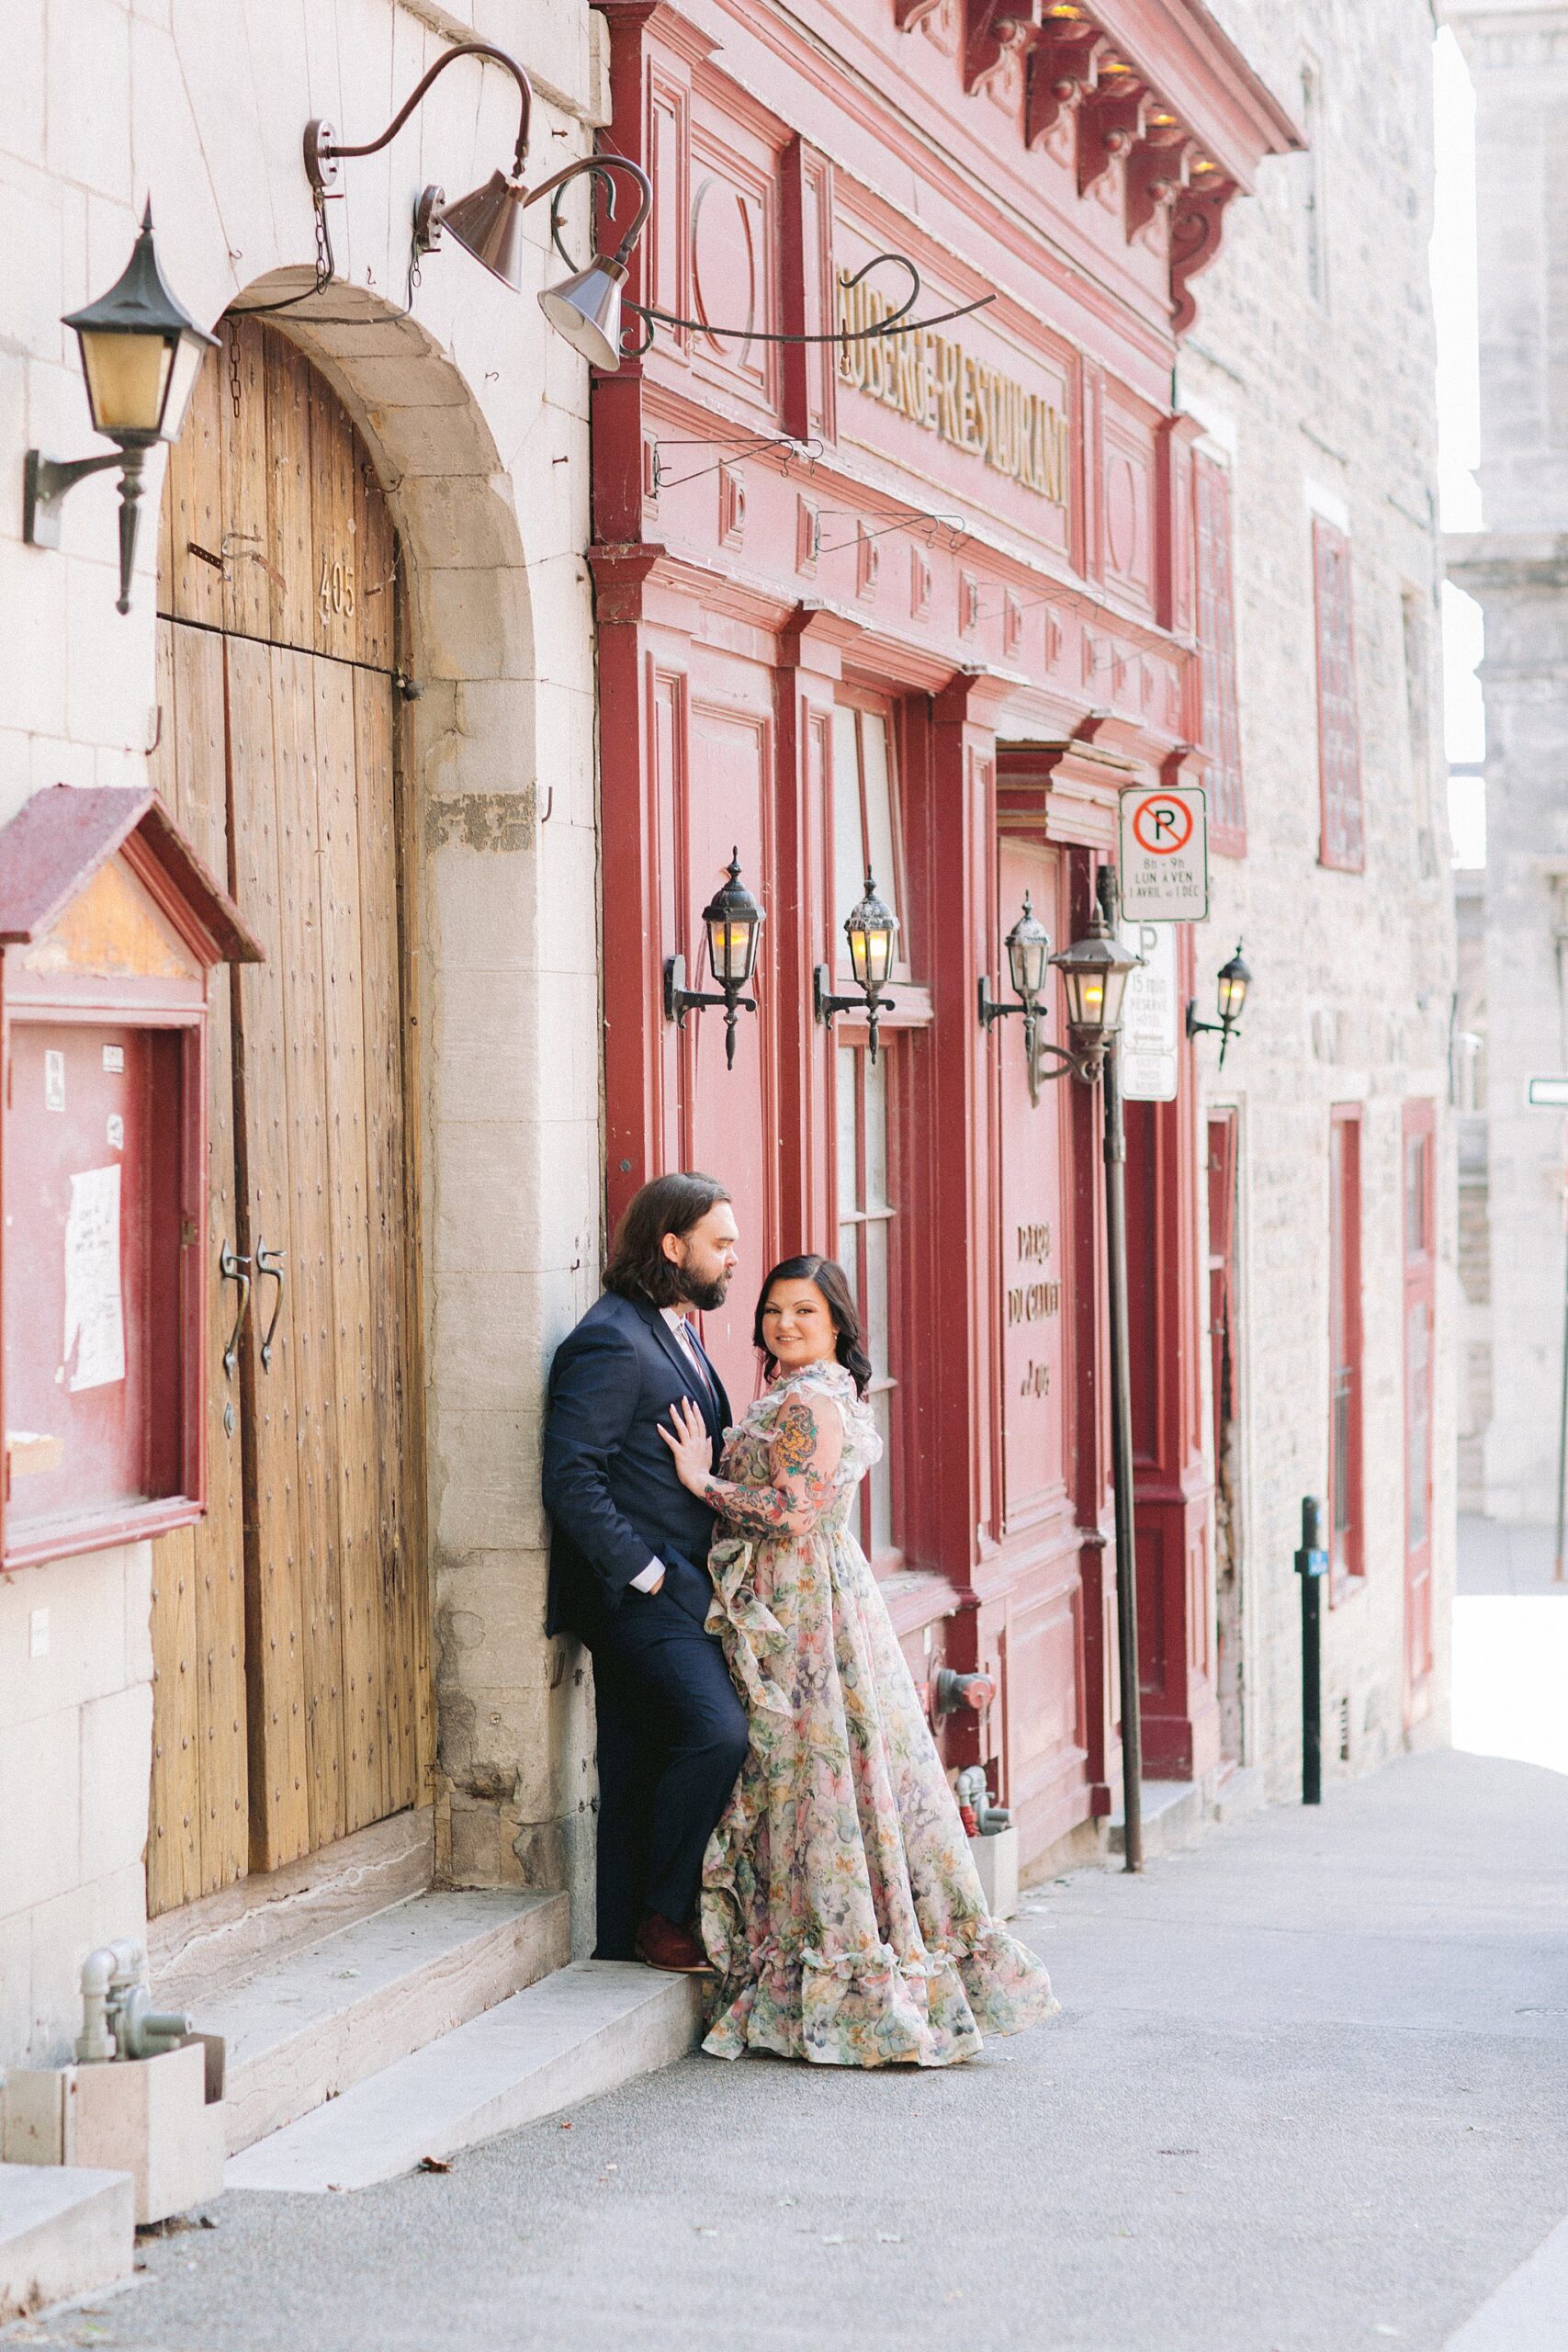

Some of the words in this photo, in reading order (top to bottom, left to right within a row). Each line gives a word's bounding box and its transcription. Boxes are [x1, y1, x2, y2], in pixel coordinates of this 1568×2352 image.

[320, 559, 355, 617] 405
[1135, 872, 1156, 884] LUN
[1171, 871, 1192, 883] VEN
[1137, 886, 1160, 898] AVRIL
